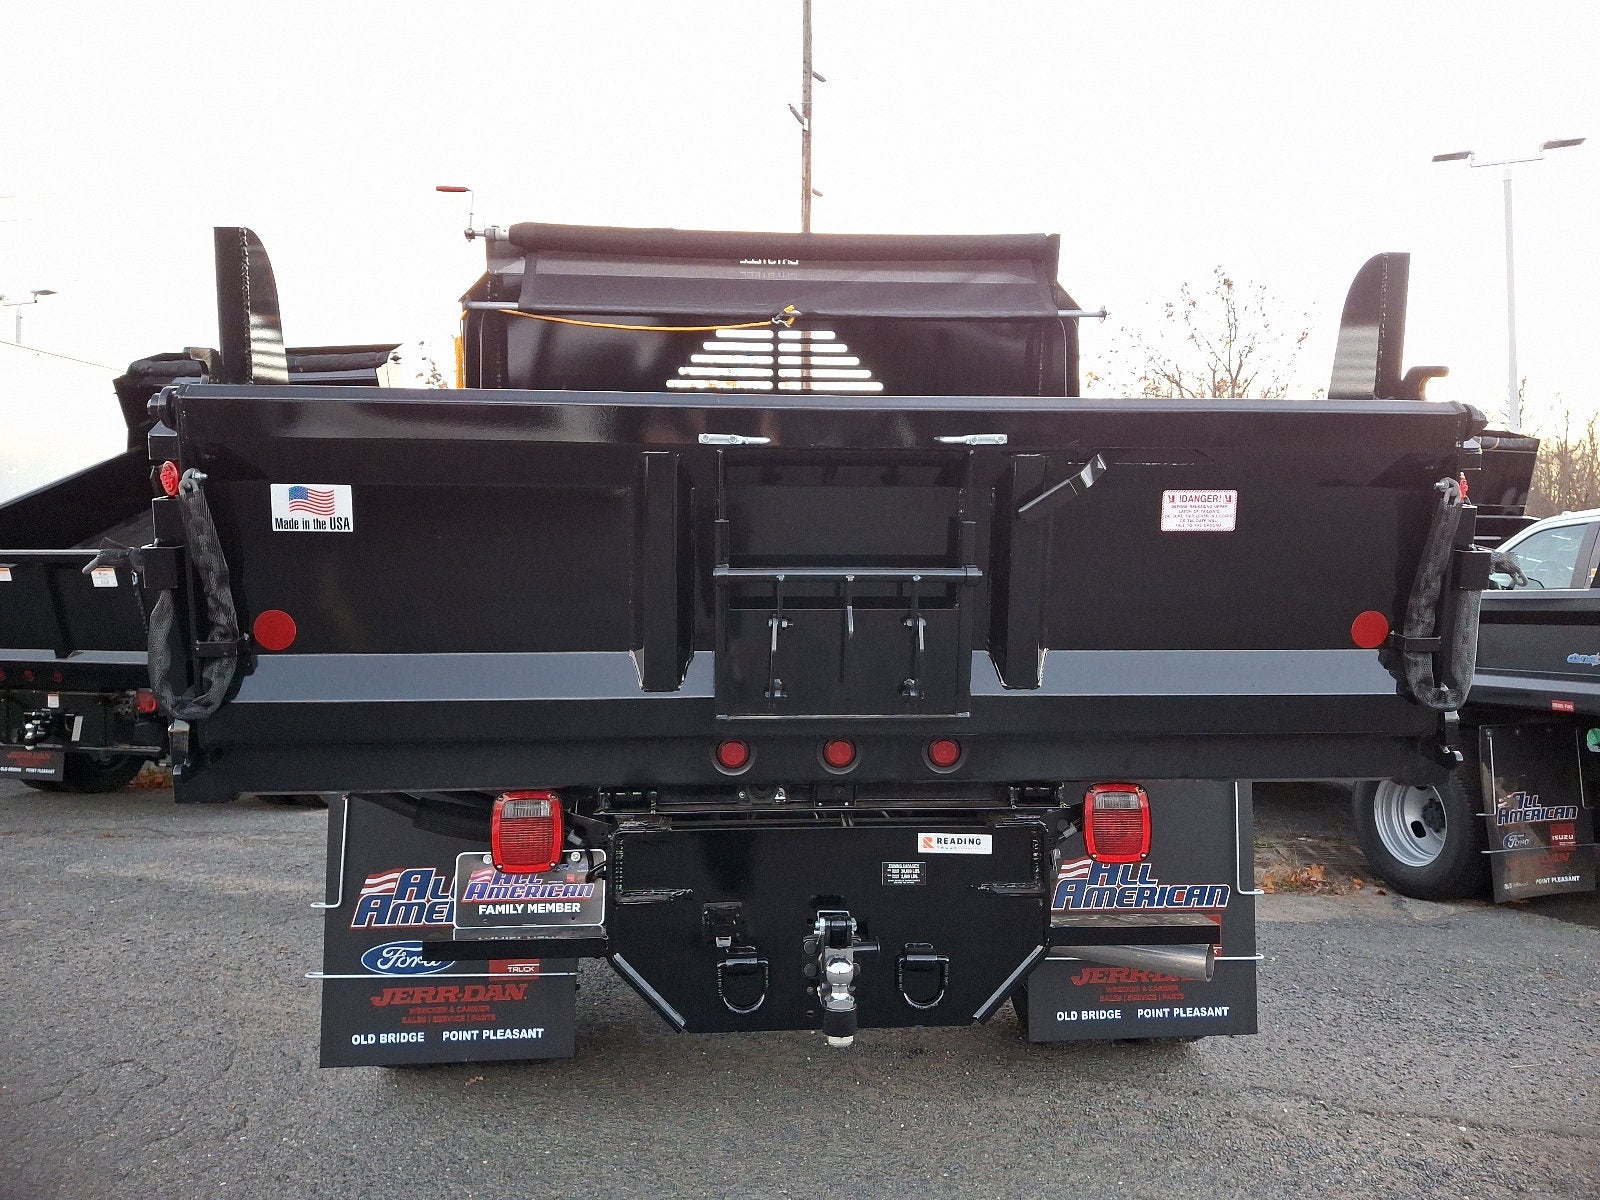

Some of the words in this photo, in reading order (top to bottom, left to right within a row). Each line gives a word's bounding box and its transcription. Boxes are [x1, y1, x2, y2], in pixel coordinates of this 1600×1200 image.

[275, 518, 299, 530] Made
[302, 518, 310, 530] in
[313, 518, 327, 530] the
[330, 517, 350, 531] USA
[1512, 791, 1542, 809] ALL
[1497, 806, 1578, 826] AMERICAN
[937, 837, 982, 846] READING
[1087, 860, 1158, 886] ALL
[1535, 877, 1550, 885] POINT
[1551, 875, 1580, 883] PLEASANT
[464, 882, 594, 901] AMERICAN
[1052, 878, 1230, 910] AMERICAN
[478, 904, 525, 915] FAMILY
[528, 903, 581, 914] MEMBER
[507, 965, 535, 973] TRUCK
[370, 983, 528, 1007] JERR-DAN
[1057, 1011, 1078, 1021] OLD
[1081, 1010, 1122, 1020] BRIDGE
[1137, 1008, 1170, 1019] POINT
[1173, 1007, 1230, 1017] PLEASANT
[352, 1033, 376, 1045] OLD
[379, 1032, 425, 1044] BRIDGE
[442, 1029, 479, 1042] POINT
[482, 1028, 545, 1040] PLEASANT
